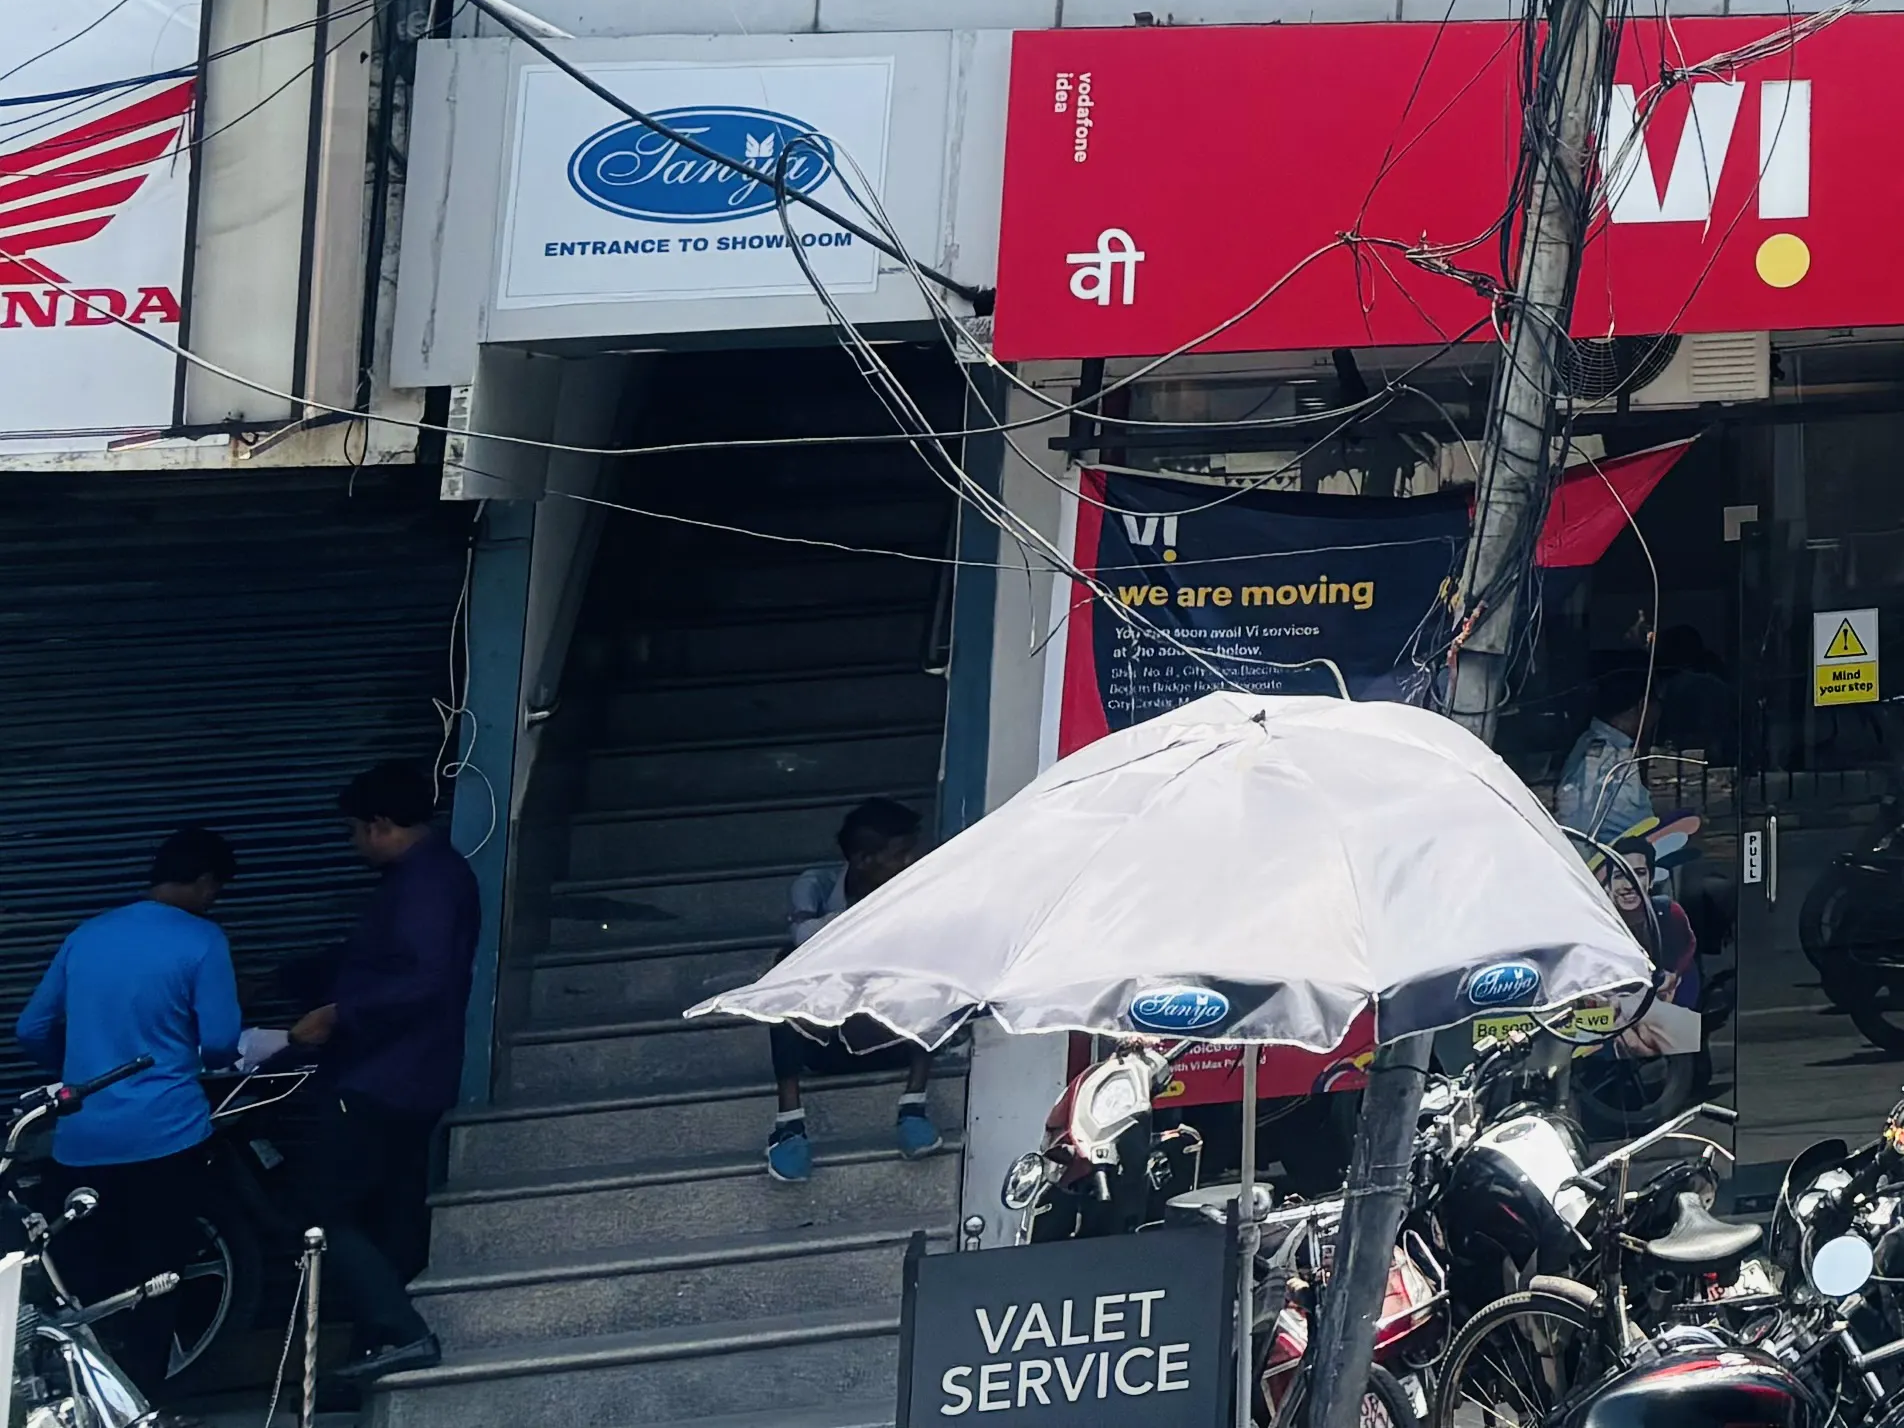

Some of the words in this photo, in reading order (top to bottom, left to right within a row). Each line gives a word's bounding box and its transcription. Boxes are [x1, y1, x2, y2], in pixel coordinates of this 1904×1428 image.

[1054, 72, 1074, 113] idea
[1074, 72, 1095, 163] vodafone
[544, 236, 672, 259] ENTRANCE
[678, 236, 711, 255] TO
[1066, 228, 1146, 307] वी
[1118, 585, 1169, 607] we
[1177, 586, 1233, 608] are
[1241, 574, 1375, 611] moving
[1819, 682, 1848, 696] your
[1849, 680, 1875, 696] step
[1831, 668, 1862, 682] Mind
[1747, 834, 1759, 881] PULL
[1477, 1023, 1497, 1039] Be
[975, 1290, 1167, 1354] VALET
[940, 1343, 1192, 1417] SERVICE
